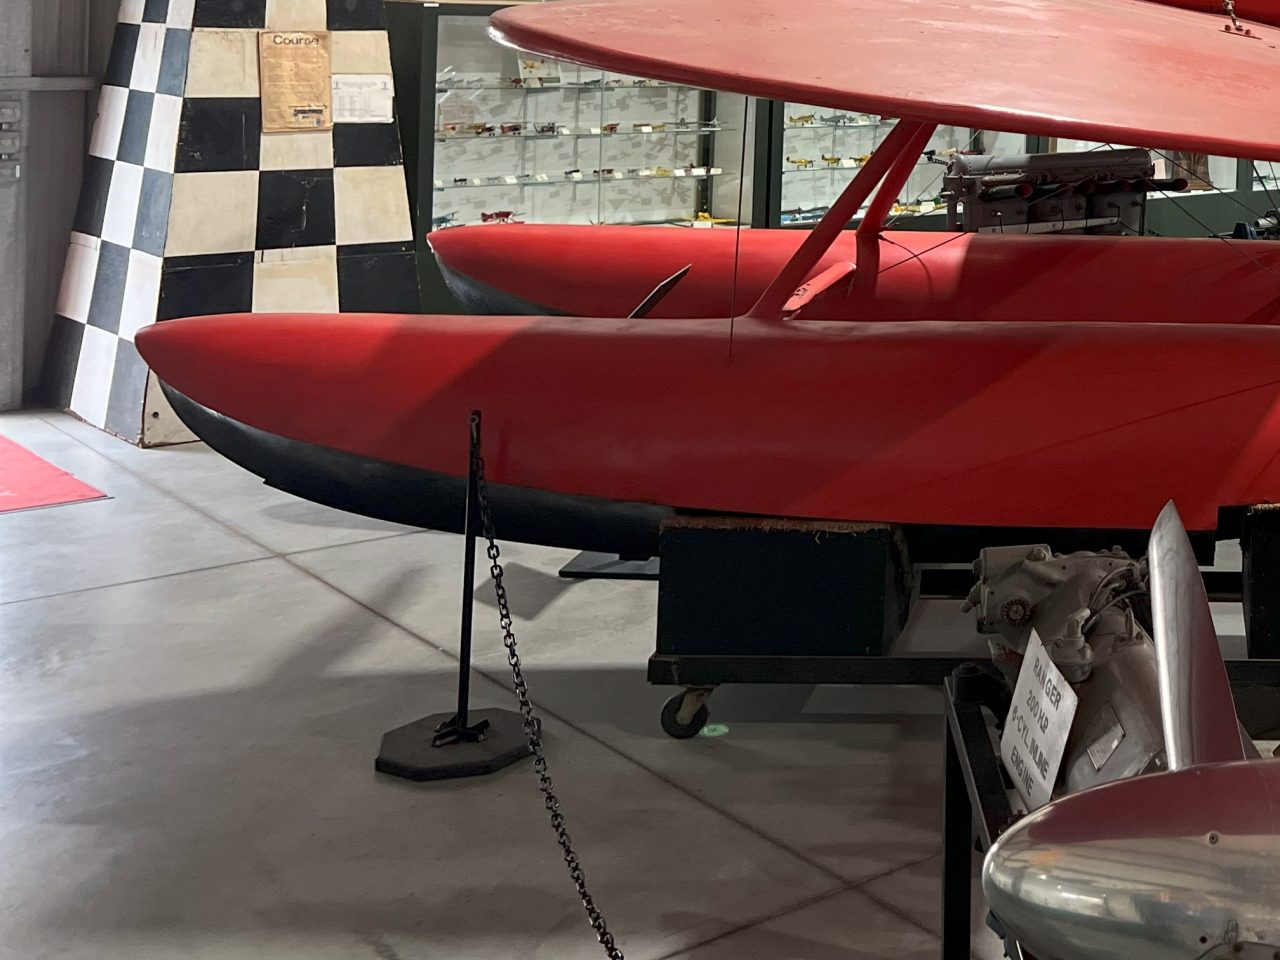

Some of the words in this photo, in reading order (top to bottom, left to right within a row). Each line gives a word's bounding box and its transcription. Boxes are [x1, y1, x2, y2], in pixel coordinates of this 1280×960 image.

[273, 34, 320, 46] Course
[1026, 689, 1040, 719] 200
[1033, 657, 1062, 711] RANGER
[1010, 744, 1034, 798] ENGINE
[1029, 737, 1050, 782] INLINE
